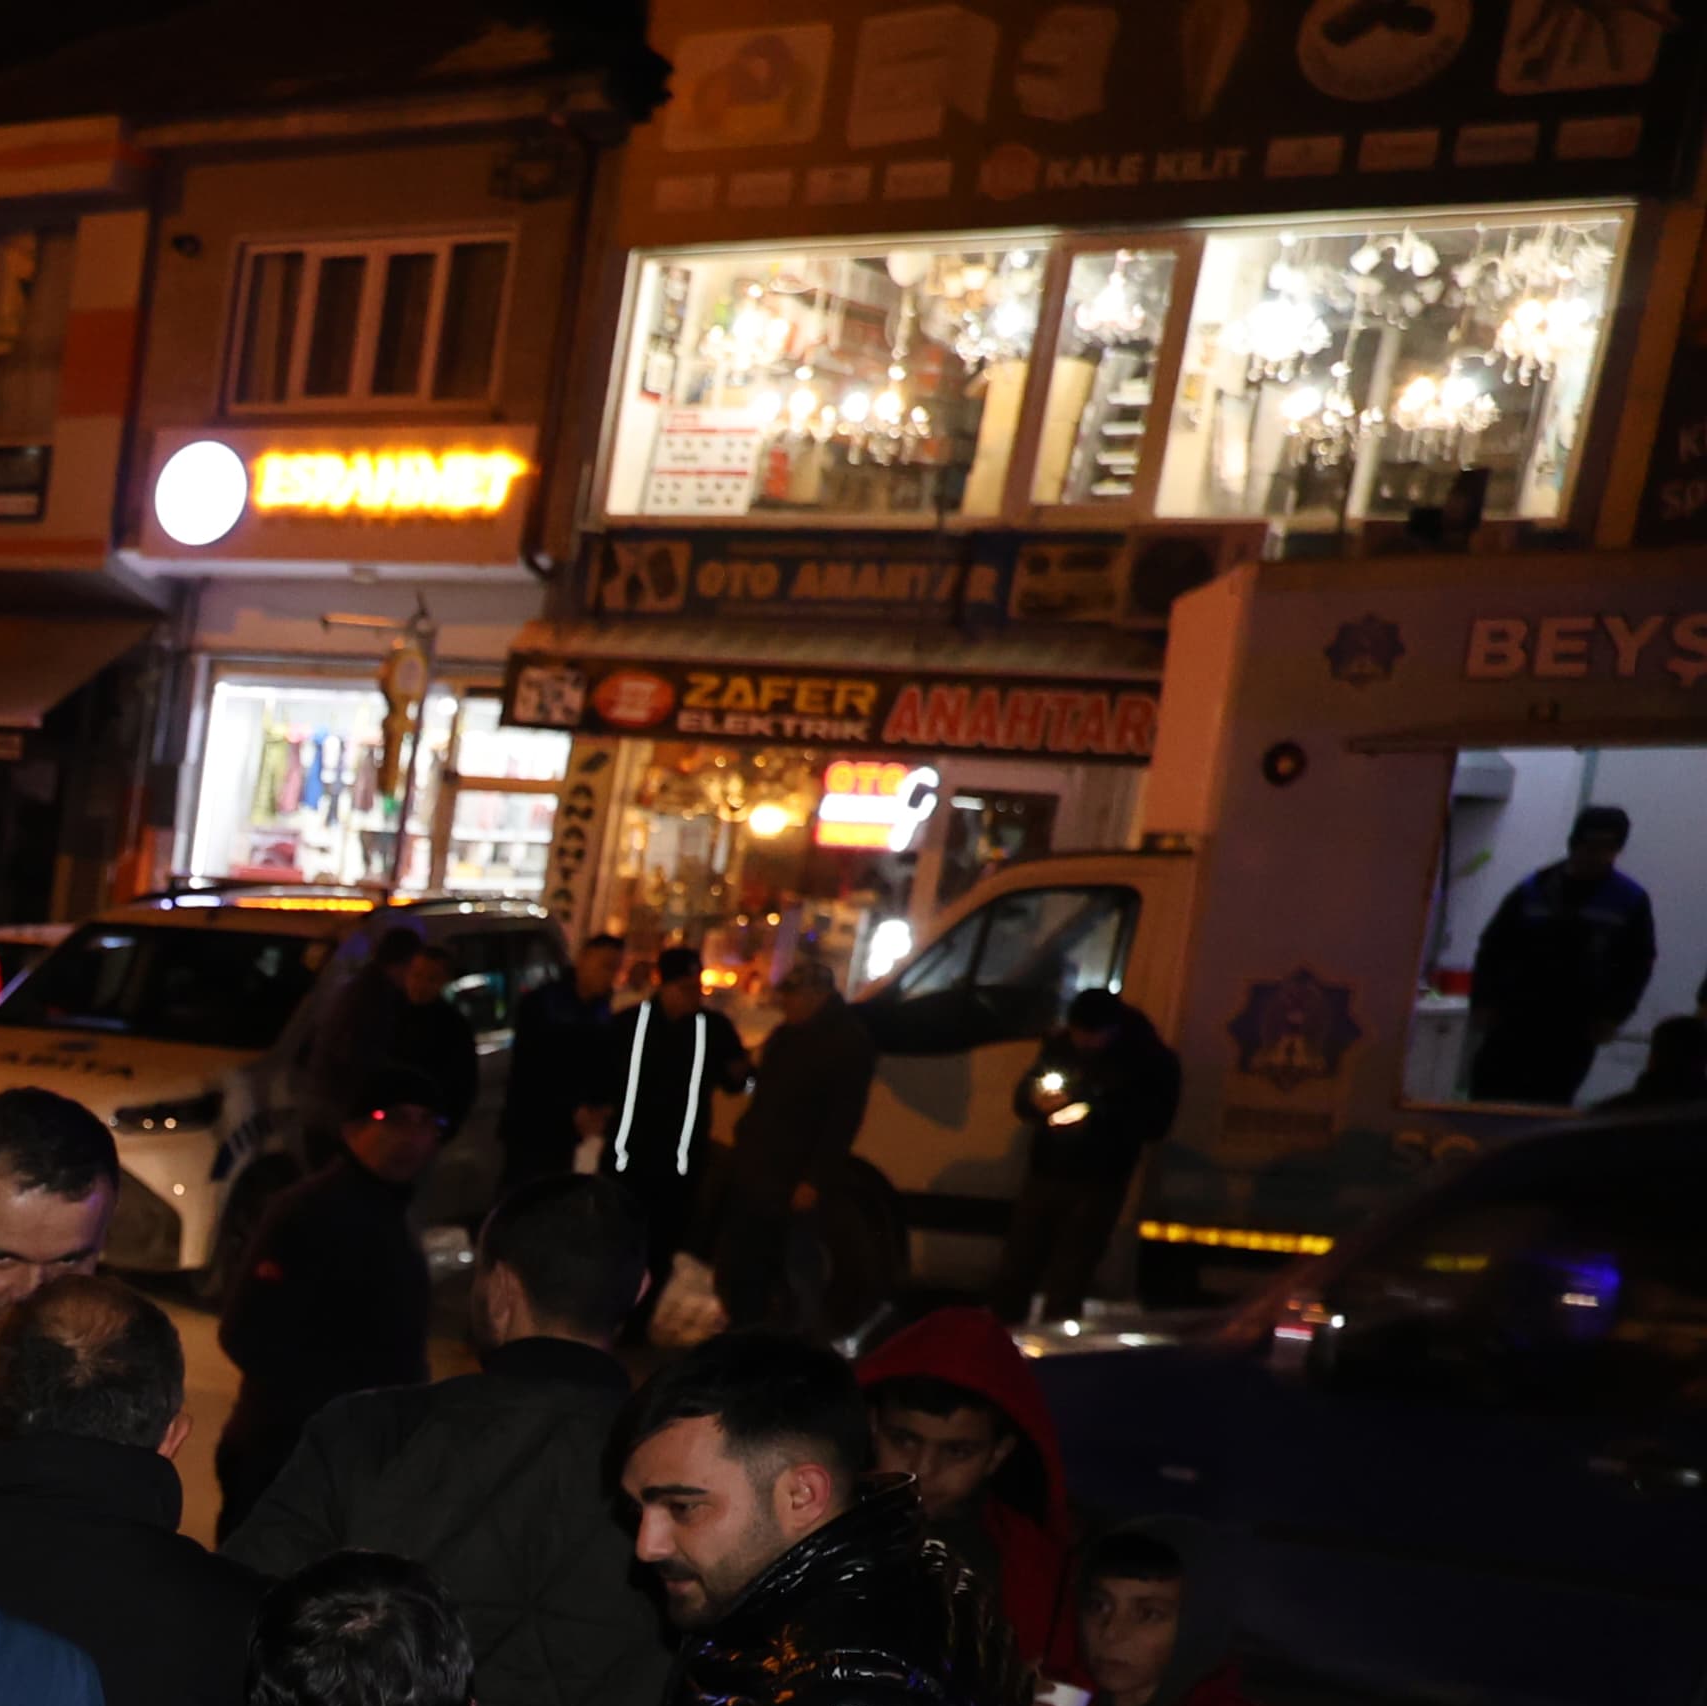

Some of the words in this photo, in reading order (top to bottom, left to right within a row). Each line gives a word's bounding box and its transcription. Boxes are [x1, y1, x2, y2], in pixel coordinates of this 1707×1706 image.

[696, 559, 781, 601] OTO
[683, 671, 880, 717] ZAFER
[881, 683, 1157, 754] ANAHTAR
[825, 760, 909, 795] OTO
